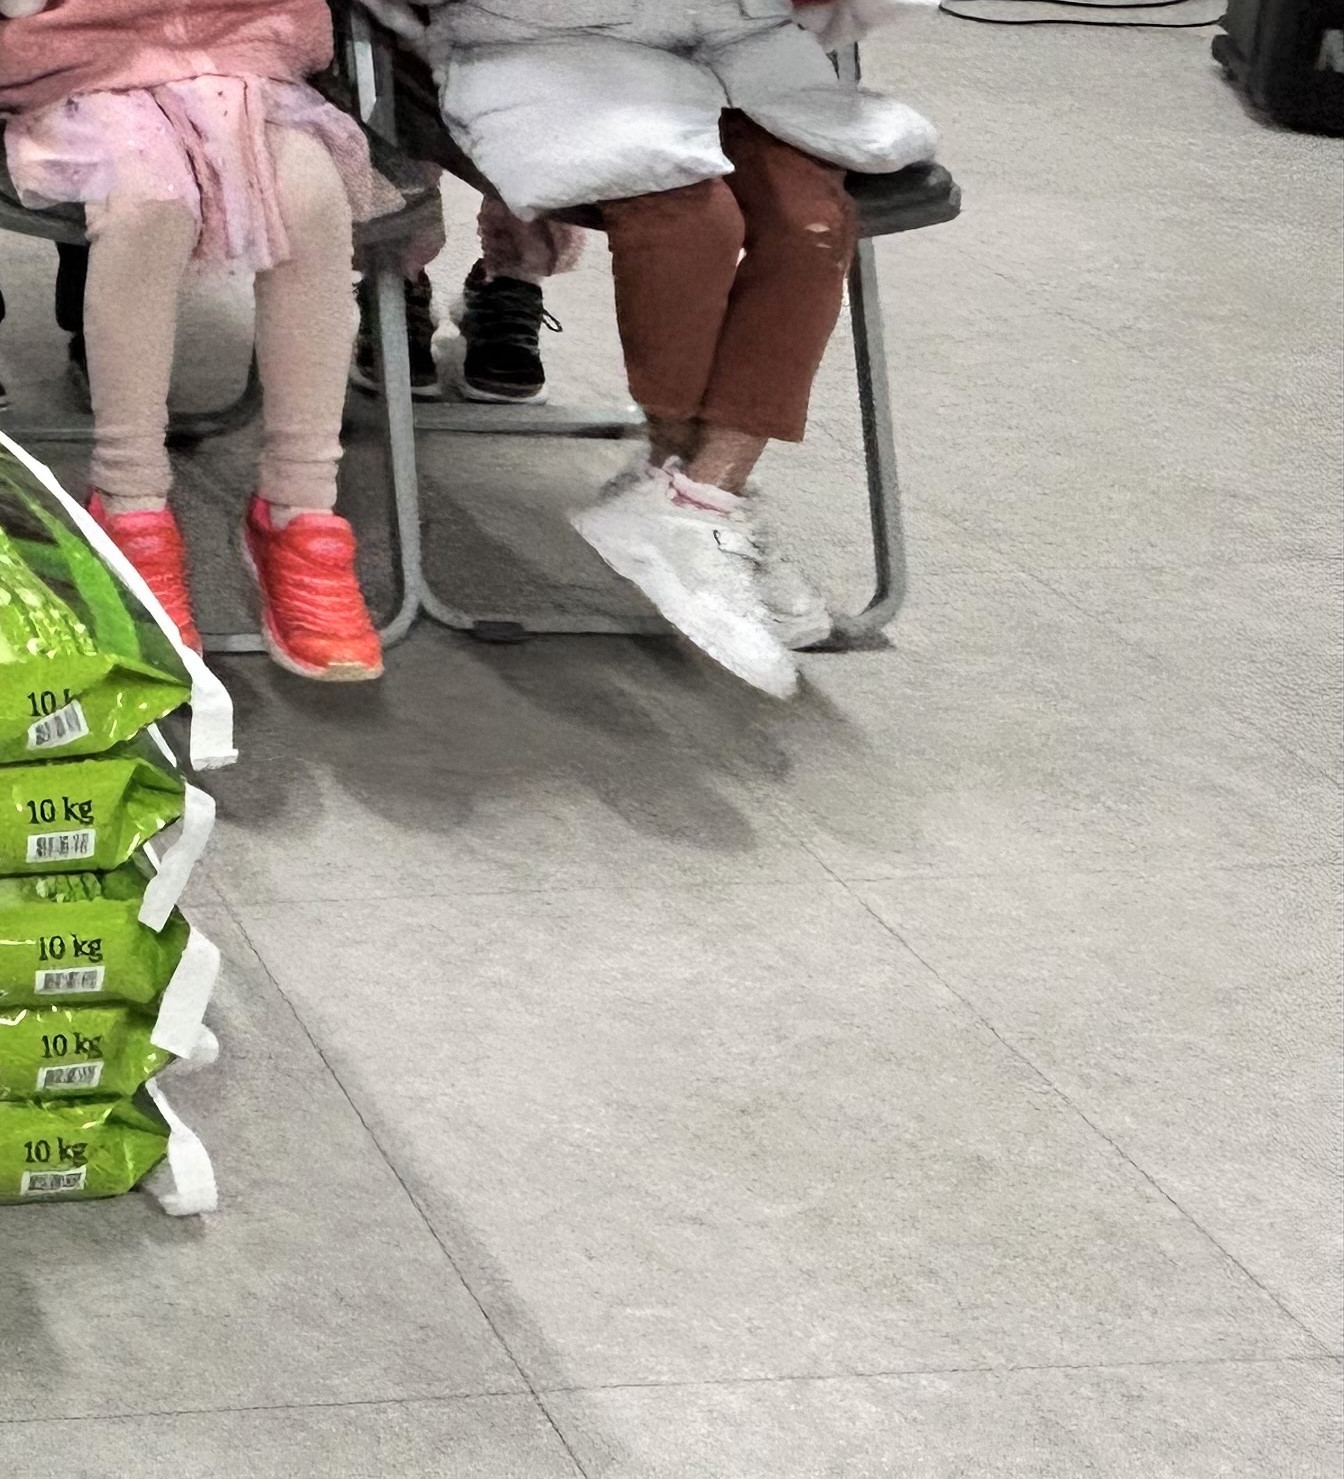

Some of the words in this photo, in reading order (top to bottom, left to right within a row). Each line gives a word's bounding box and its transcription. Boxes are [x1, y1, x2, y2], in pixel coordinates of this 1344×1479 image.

[26, 691, 56, 717] 10
[26, 798, 56, 825] 10
[38, 935, 67, 961] 10
[40, 1033, 68, 1059] 10
[22, 1140, 51, 1164] 10
